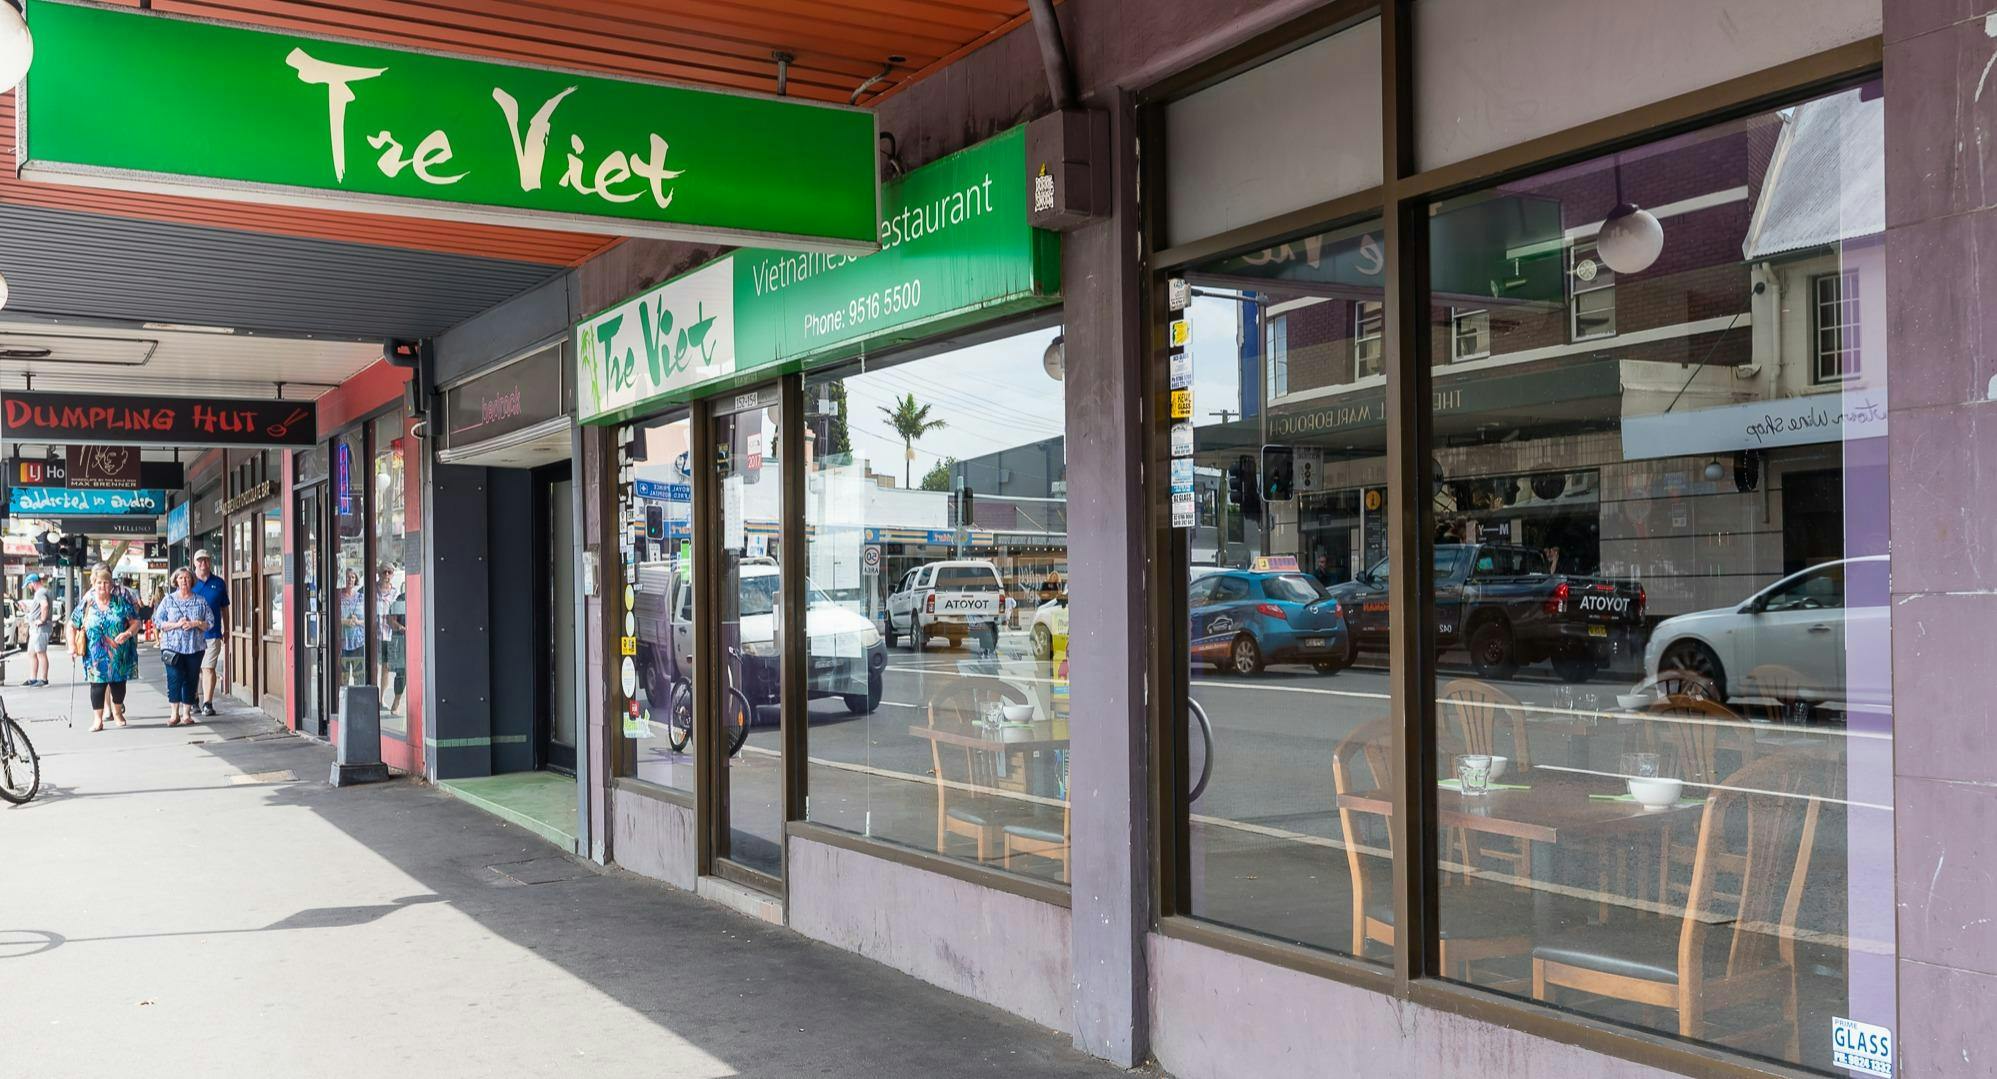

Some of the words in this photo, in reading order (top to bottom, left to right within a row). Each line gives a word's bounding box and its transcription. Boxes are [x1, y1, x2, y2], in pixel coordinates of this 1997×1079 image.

[285, 47, 470, 184] Tre
[492, 85, 685, 209] Viet
[881, 173, 992, 250] estaurant
[804, 308, 845, 338] Phone:
[849, 292, 880, 326] 9516
[884, 279, 921, 315] 5500
[597, 314, 636, 406] Tre
[639, 294, 717, 387] Viet
[5, 400, 175, 430] DUMPLING
[193, 405, 258, 432] HUT
[19, 489, 89, 510] addicted
[111, 491, 155, 509] audio
[1834, 1018, 1858, 1029] PRIME
[1835, 1027, 1888, 1056] GLASS
